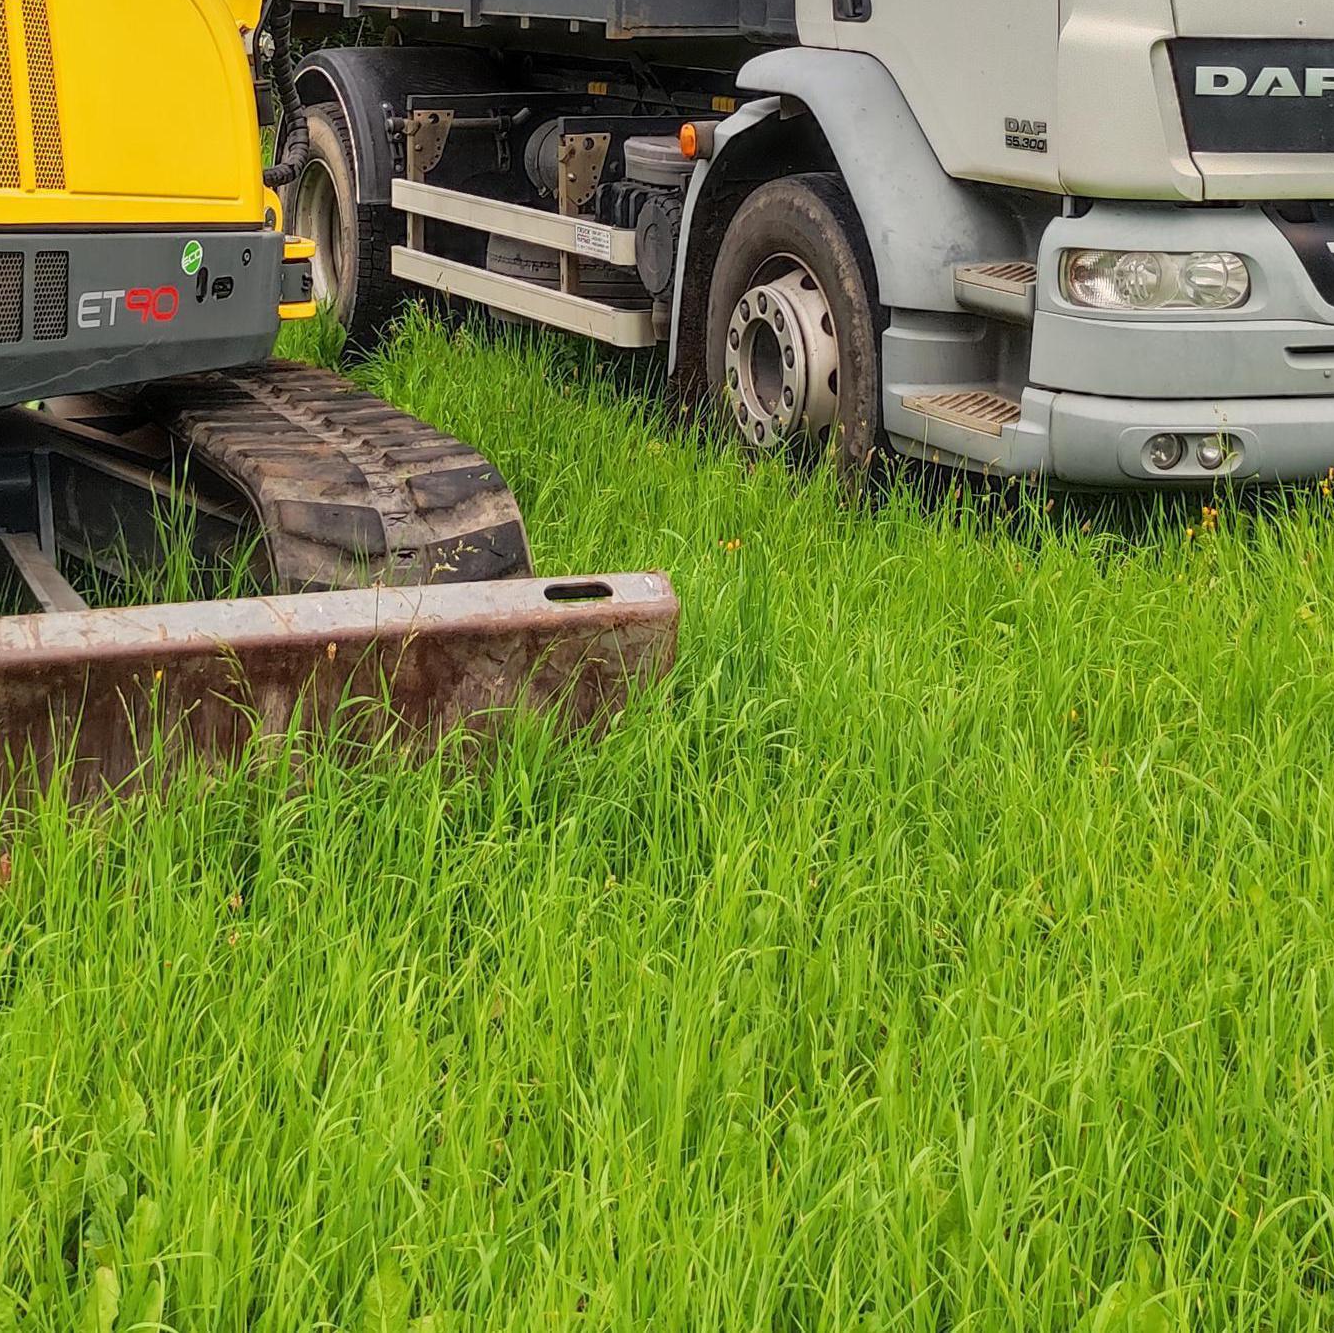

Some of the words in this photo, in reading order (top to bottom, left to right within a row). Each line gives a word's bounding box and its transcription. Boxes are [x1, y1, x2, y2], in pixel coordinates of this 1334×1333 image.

[1005, 117, 1047, 136] DAF
[182, 248, 203, 268] ECO
[77, 285, 180, 329] ET90
